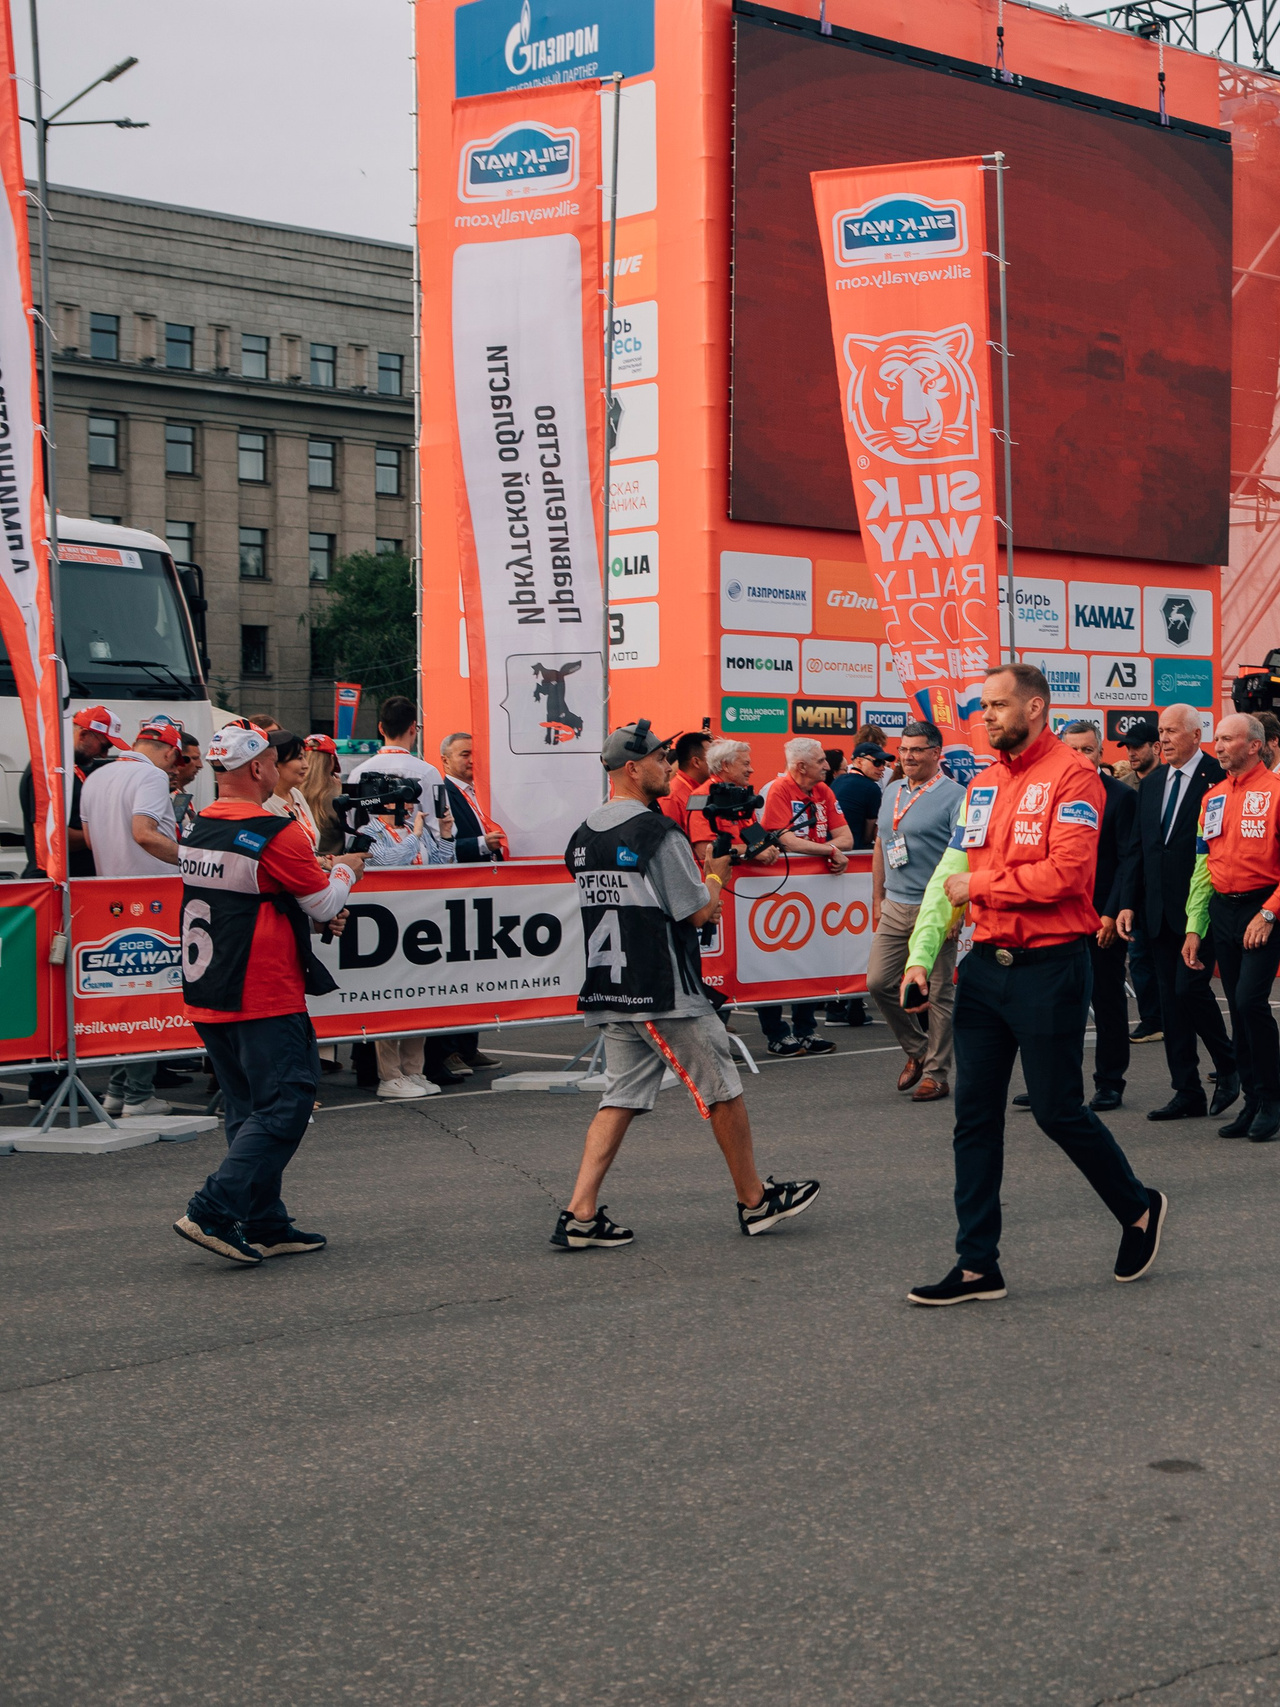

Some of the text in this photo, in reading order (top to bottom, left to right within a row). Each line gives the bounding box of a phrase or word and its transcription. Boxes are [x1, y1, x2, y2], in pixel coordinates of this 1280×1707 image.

[531, 24, 599, 71] ГАЗПРОМ
[563, 62, 598, 83] ПАРТНЕР
[603, 254, 643, 279] RIVE
[610, 480, 639, 497] СКАЯ
[610, 496, 648, 512] АНИКА
[610, 555, 650, 577] OLIA
[747, 586, 806, 601] ГАЗПРОМБАНК
[1018, 607, 1059, 622] здесь
[1075, 604, 1135, 630] KAMAZ
[726, 657, 793, 671] MONGOLIA
[824, 662, 873, 673] СОГЛАСИЕ
[1048, 671, 1080, 683] ГАЗПРОМ
[1094, 692, 1148, 700] ЛЕНЗОЛОТО
[754, 708, 785, 716] НОВОСТИ
[796, 706, 853, 729] МАТЧ!
[868, 714, 903, 725] РОССИЯ
[360, 798, 381, 807] RONIN
[1014, 821, 1044, 833] SILK
[1241, 819, 1266, 829] SILK
[1014, 833, 1043, 845] WAY
[1241, 829, 1265, 838] WAY
[574, 857, 586, 867] WAY
[585, 890, 620, 904] HOTO
[182, 899, 213, 983] 6
[339, 897, 562, 970] Delko
[119, 940, 154, 950] 2025
[587, 909, 627, 984] 4
[86, 949, 182, 969] SILK WAY
[116, 966, 156, 974] RALLY
[339, 976, 561, 1004] ТРАНСПОРТНАЯ КОМПАНИЯ
[74, 1015, 194, 1035] #silkwayrally202
